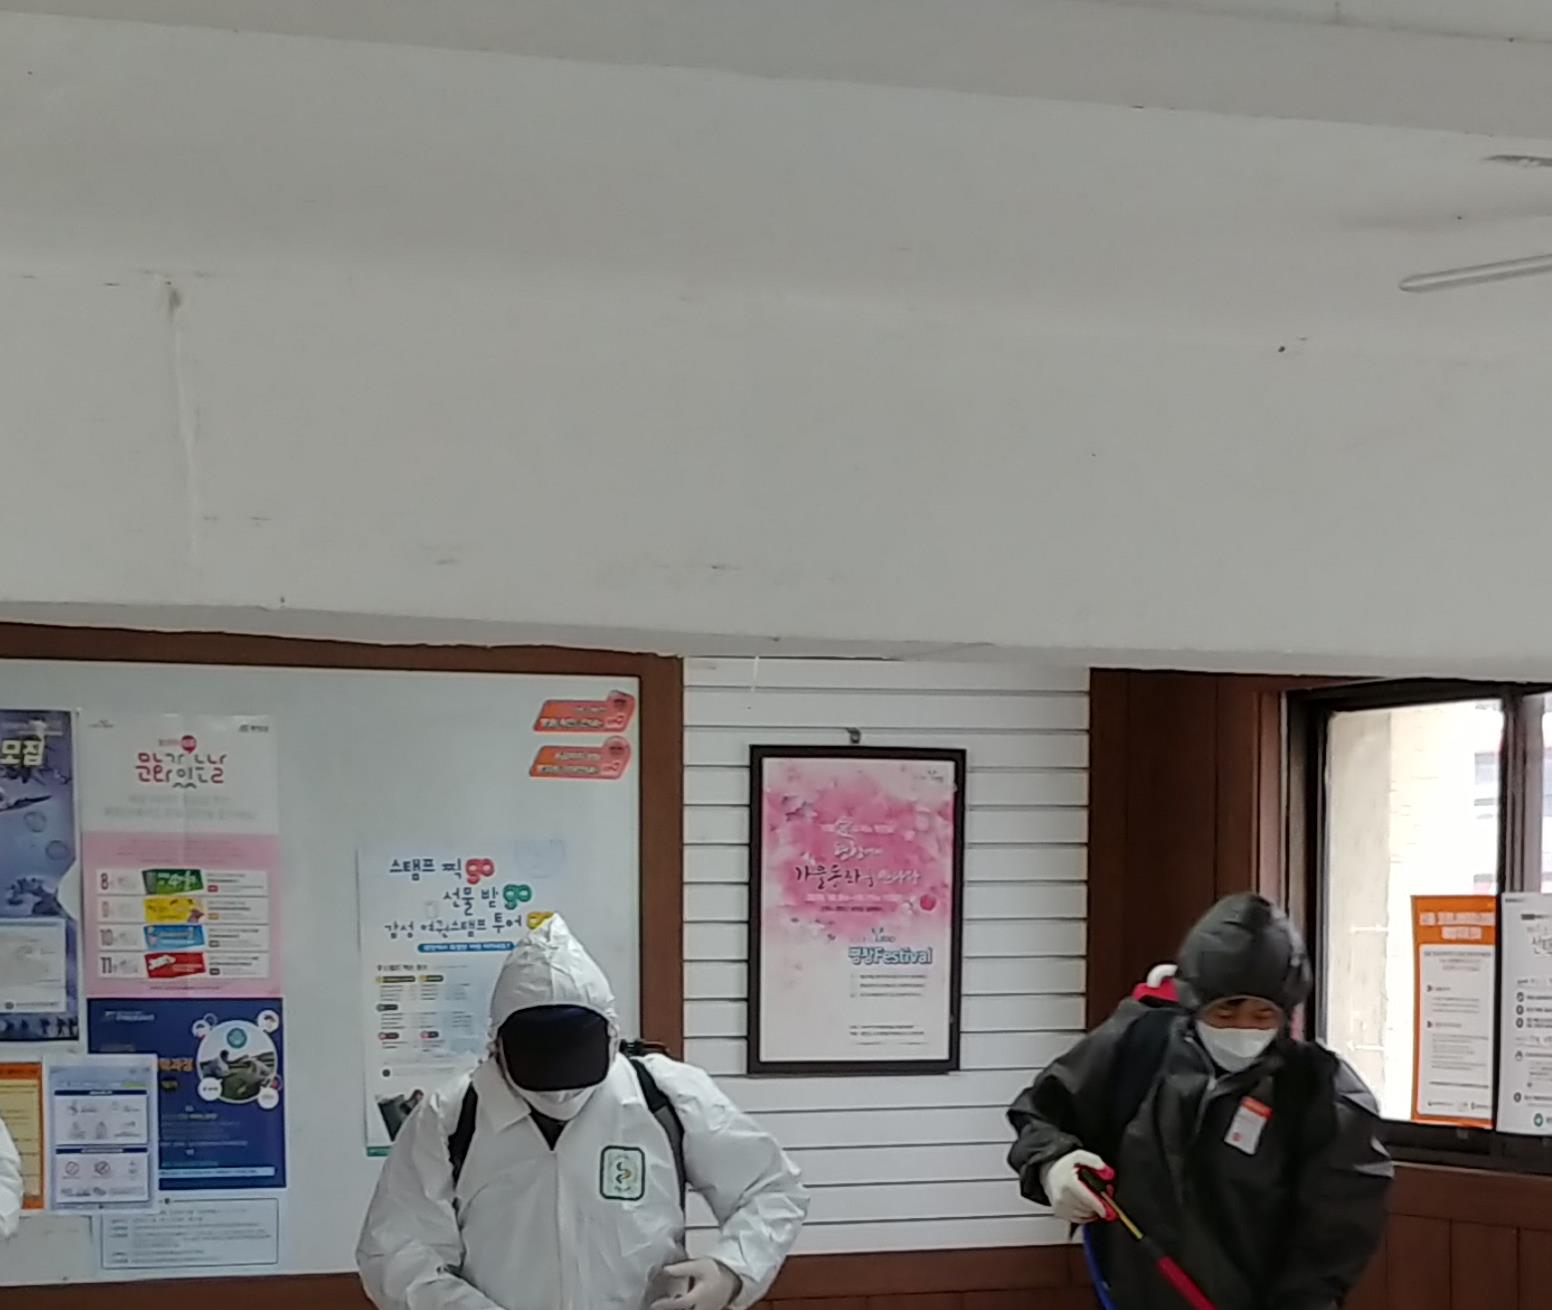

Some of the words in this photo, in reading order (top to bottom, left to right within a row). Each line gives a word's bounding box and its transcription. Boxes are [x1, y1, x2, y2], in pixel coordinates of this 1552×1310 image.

[0, 738, 45, 766] 모집
[389, 858, 436, 882] 스탬프
[443, 887, 474, 916] 선물
